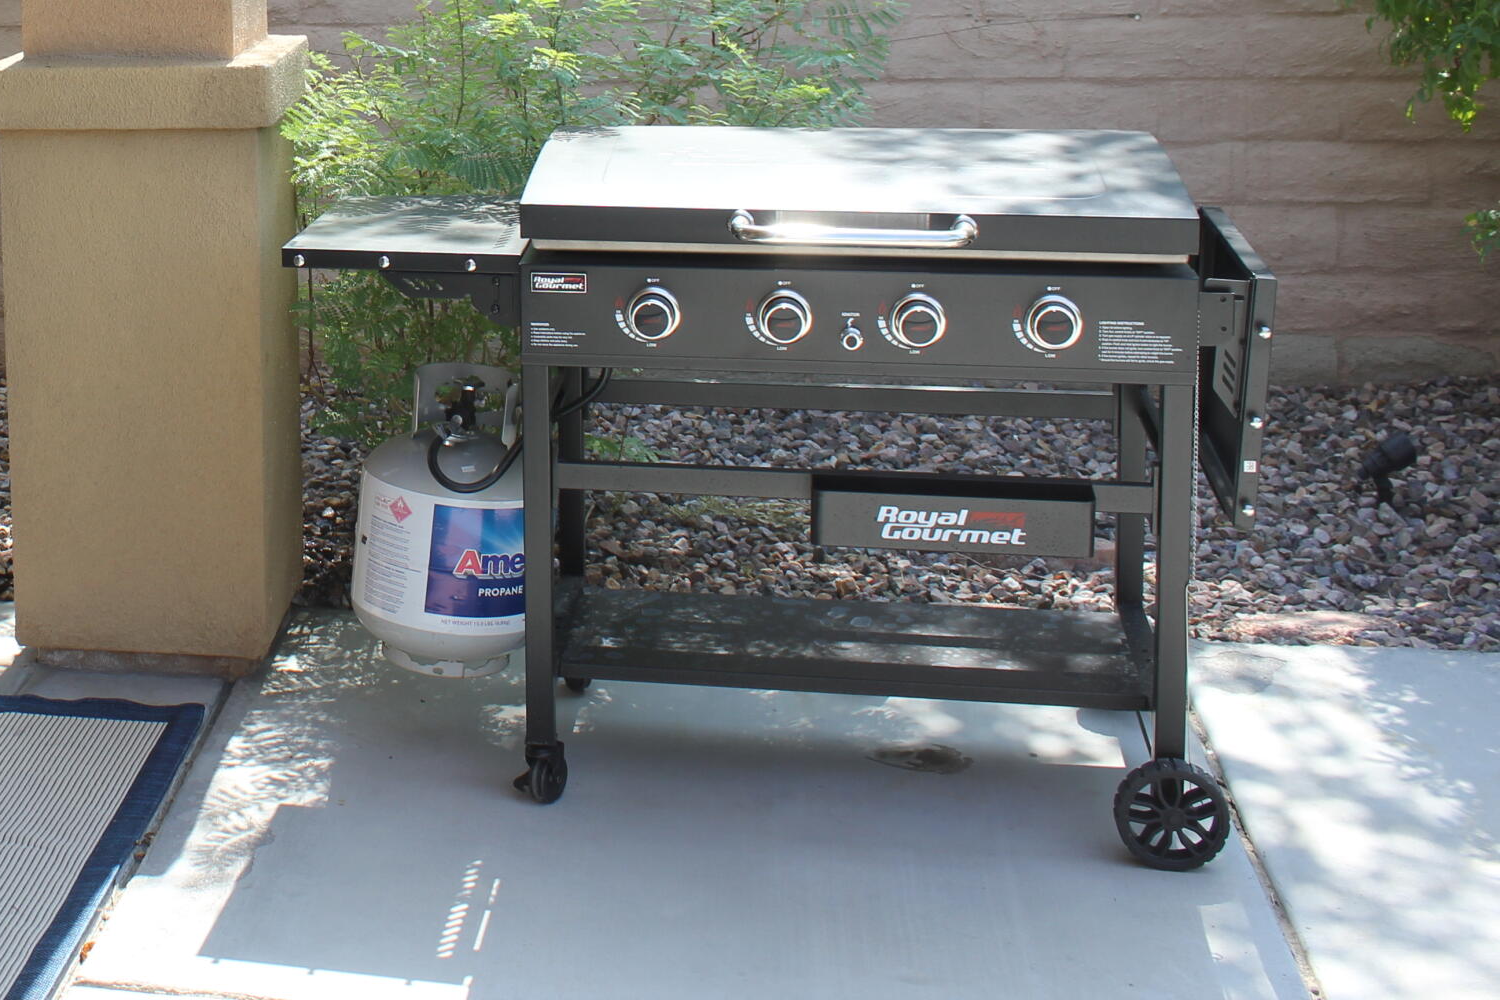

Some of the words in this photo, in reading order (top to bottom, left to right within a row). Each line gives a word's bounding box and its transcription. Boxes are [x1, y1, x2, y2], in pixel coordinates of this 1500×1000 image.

[533, 276, 565, 284] Royal
[535, 282, 585, 290] Gourmet
[876, 505, 969, 528] Royal
[881, 523, 1027, 545] Gourmet
[478, 585, 524, 597] PROPANE
